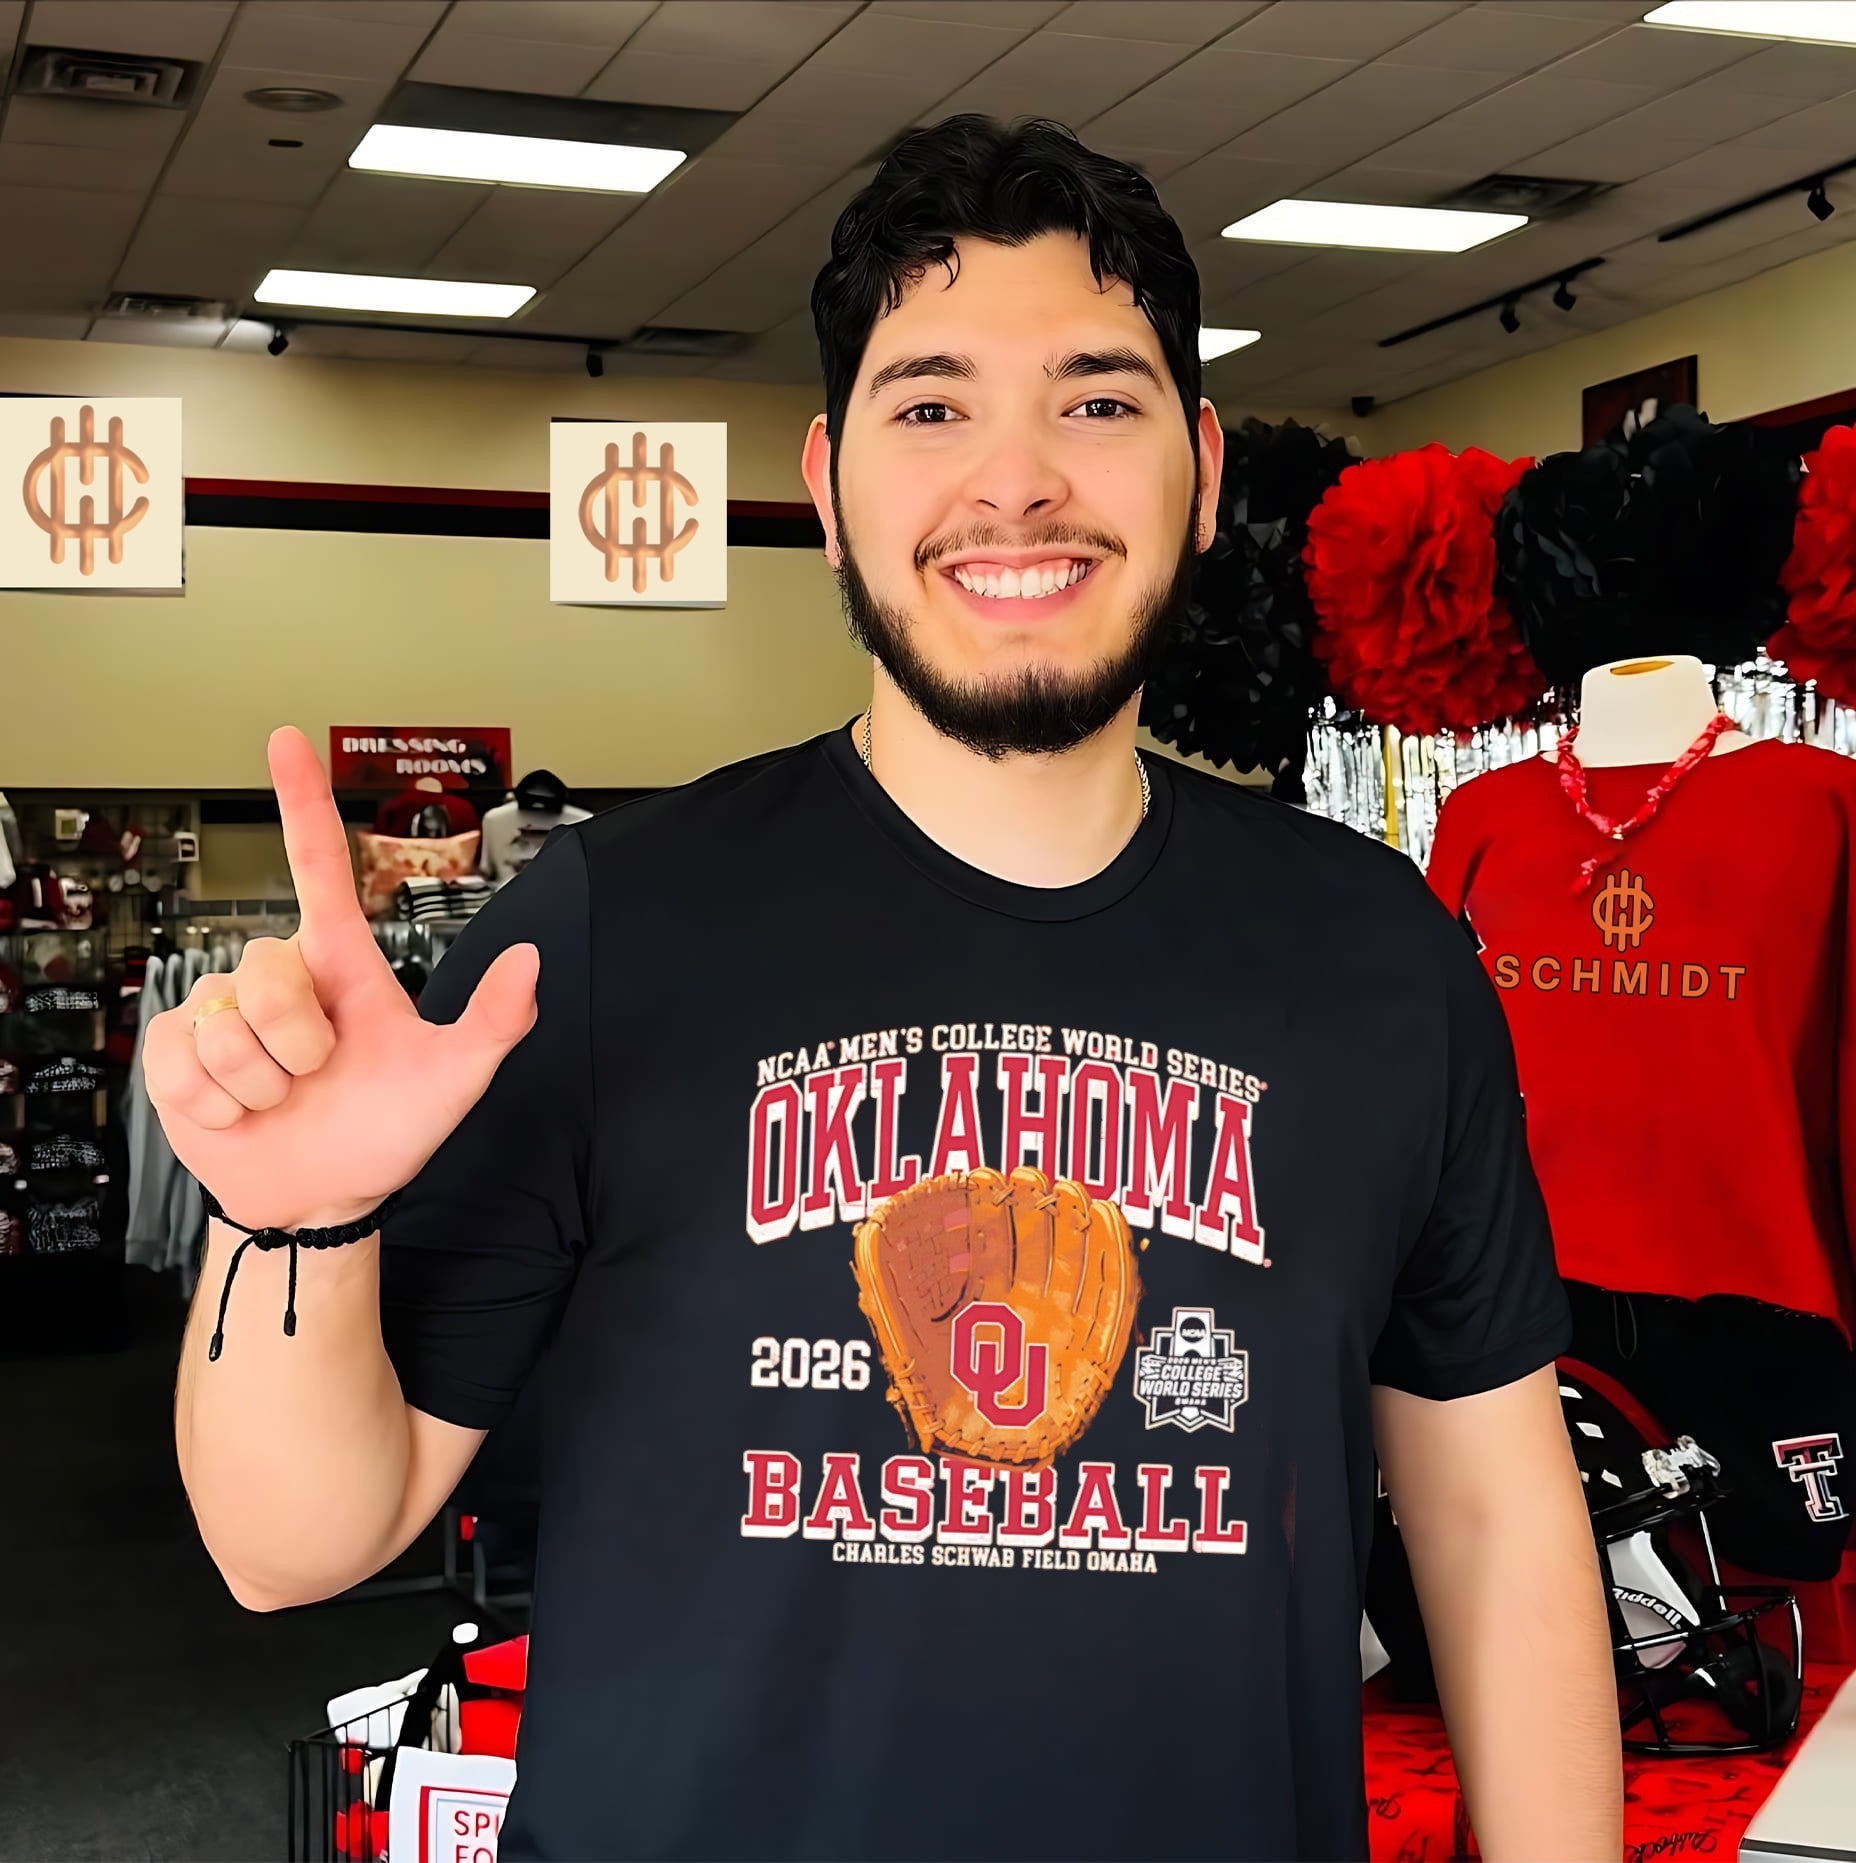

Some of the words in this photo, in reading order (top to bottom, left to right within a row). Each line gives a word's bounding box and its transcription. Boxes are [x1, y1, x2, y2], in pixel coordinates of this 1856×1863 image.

[396, 758, 487, 775] ROOMS
[1494, 953, 1747, 1000] SCHMIDT
[839, 1026, 924, 1064] MEN'S
[932, 1023, 1052, 1052] COLLEGE
[1061, 1027, 1159, 1070] WORLD
[1166, 1048, 1261, 1103] SERIES
[746, 1052, 1265, 1265] OKLAHOMA
[751, 1337, 872, 1391] 2026
[950, 1301, 1049, 1429] OU
[1161, 1364, 1223, 1382] COLLEGE
[1140, 1380, 1190, 1397] WORLD
[1191, 1381, 1243, 1399] SERIES
[741, 1449, 1248, 1555] BASEBALL
[832, 1542, 925, 1565] CHARLES
[931, 1545, 1015, 1569] SCHWAB
[1022, 1549, 1080, 1571] FIELD
[1086, 1550, 1158, 1573] OMAHA
